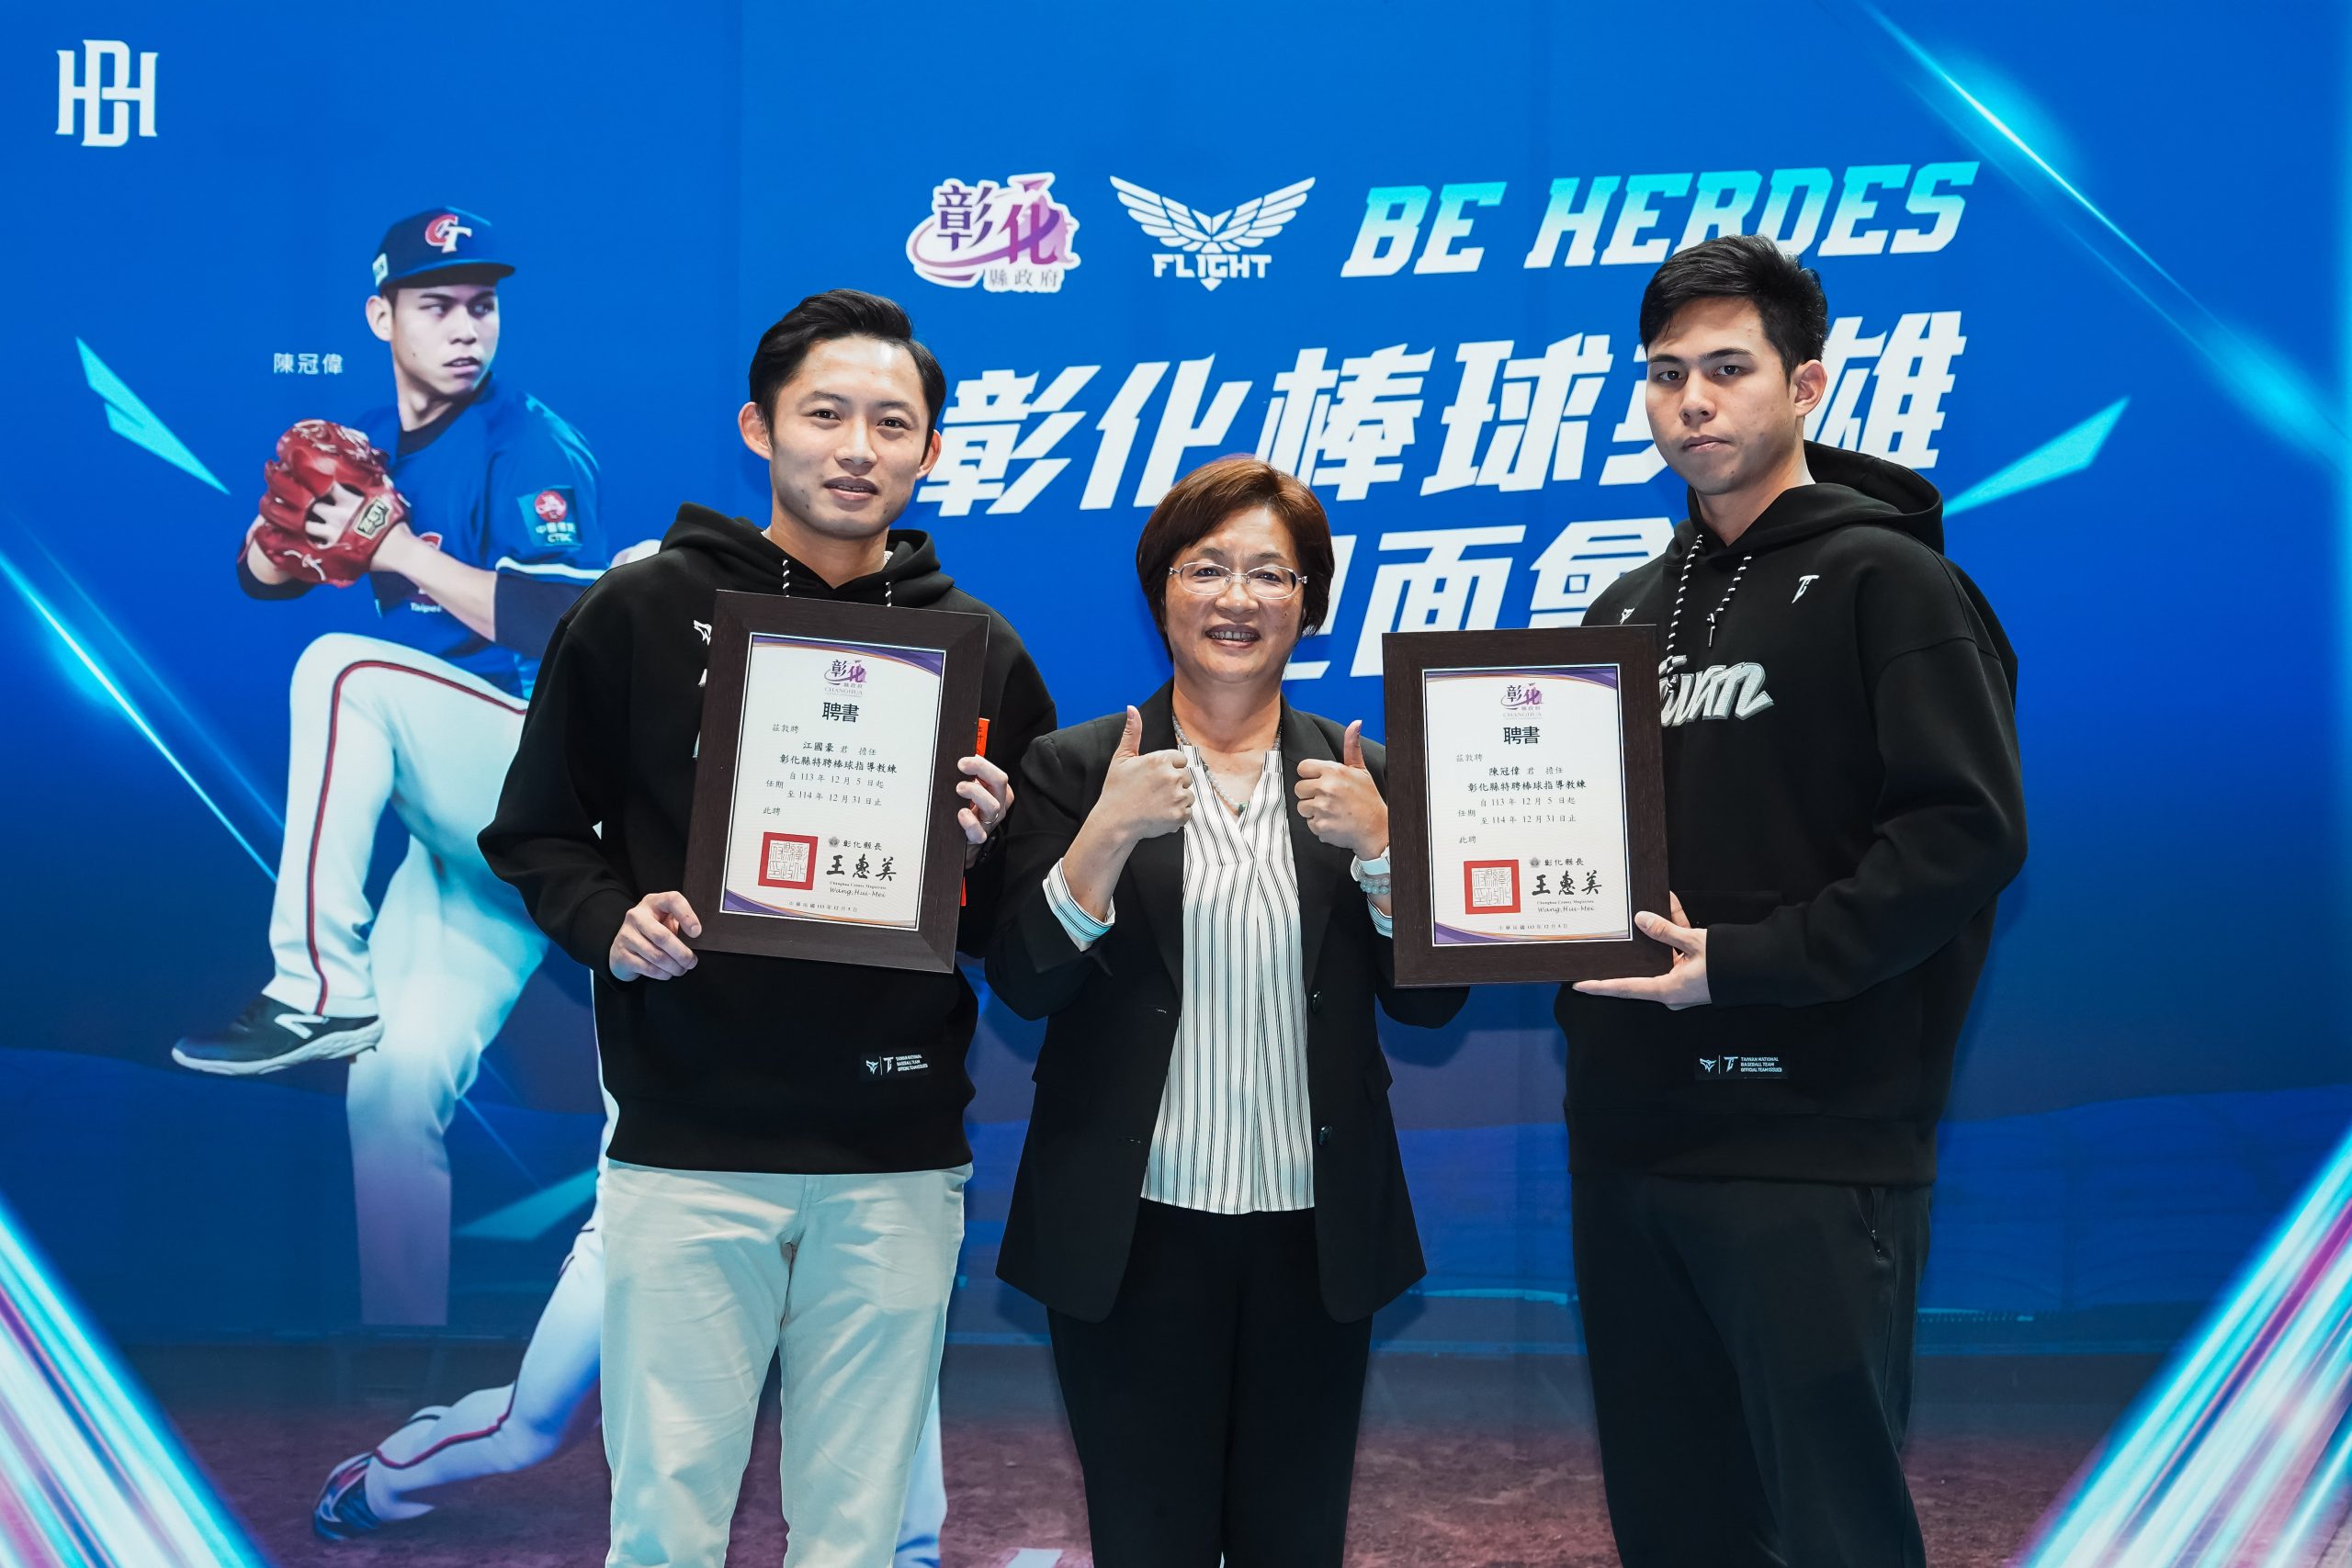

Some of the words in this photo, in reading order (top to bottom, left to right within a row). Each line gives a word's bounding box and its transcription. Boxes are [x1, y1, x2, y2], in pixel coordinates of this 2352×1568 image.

[937, 184, 1058, 265] 彰化
[1340, 182, 1508, 277] BE
[1523, 161, 1980, 269] HEROES
[1152, 254, 1272, 278] FLIGHT
[989, 268, 1058, 288] 縣政府
[273, 352, 344, 375] 陳冠偉
[1282, 516, 1676, 681] 面會
[822, 702, 860, 723] 聘書
[1503, 726, 1541, 745] 聘書
[779, 753, 898, 773] 彰化縣特聘棒球指導教練
[1489, 766, 1521, 776] 陳冠偉
[1467, 779, 1587, 792] 彰化縣特聘棒球指導教練
[842, 840, 882, 852] 彰化縣長
[826, 853, 897, 882] 王惠美
[1544, 857, 1585, 867] 彰化縣長
[1532, 870, 1602, 897] 王惠美
